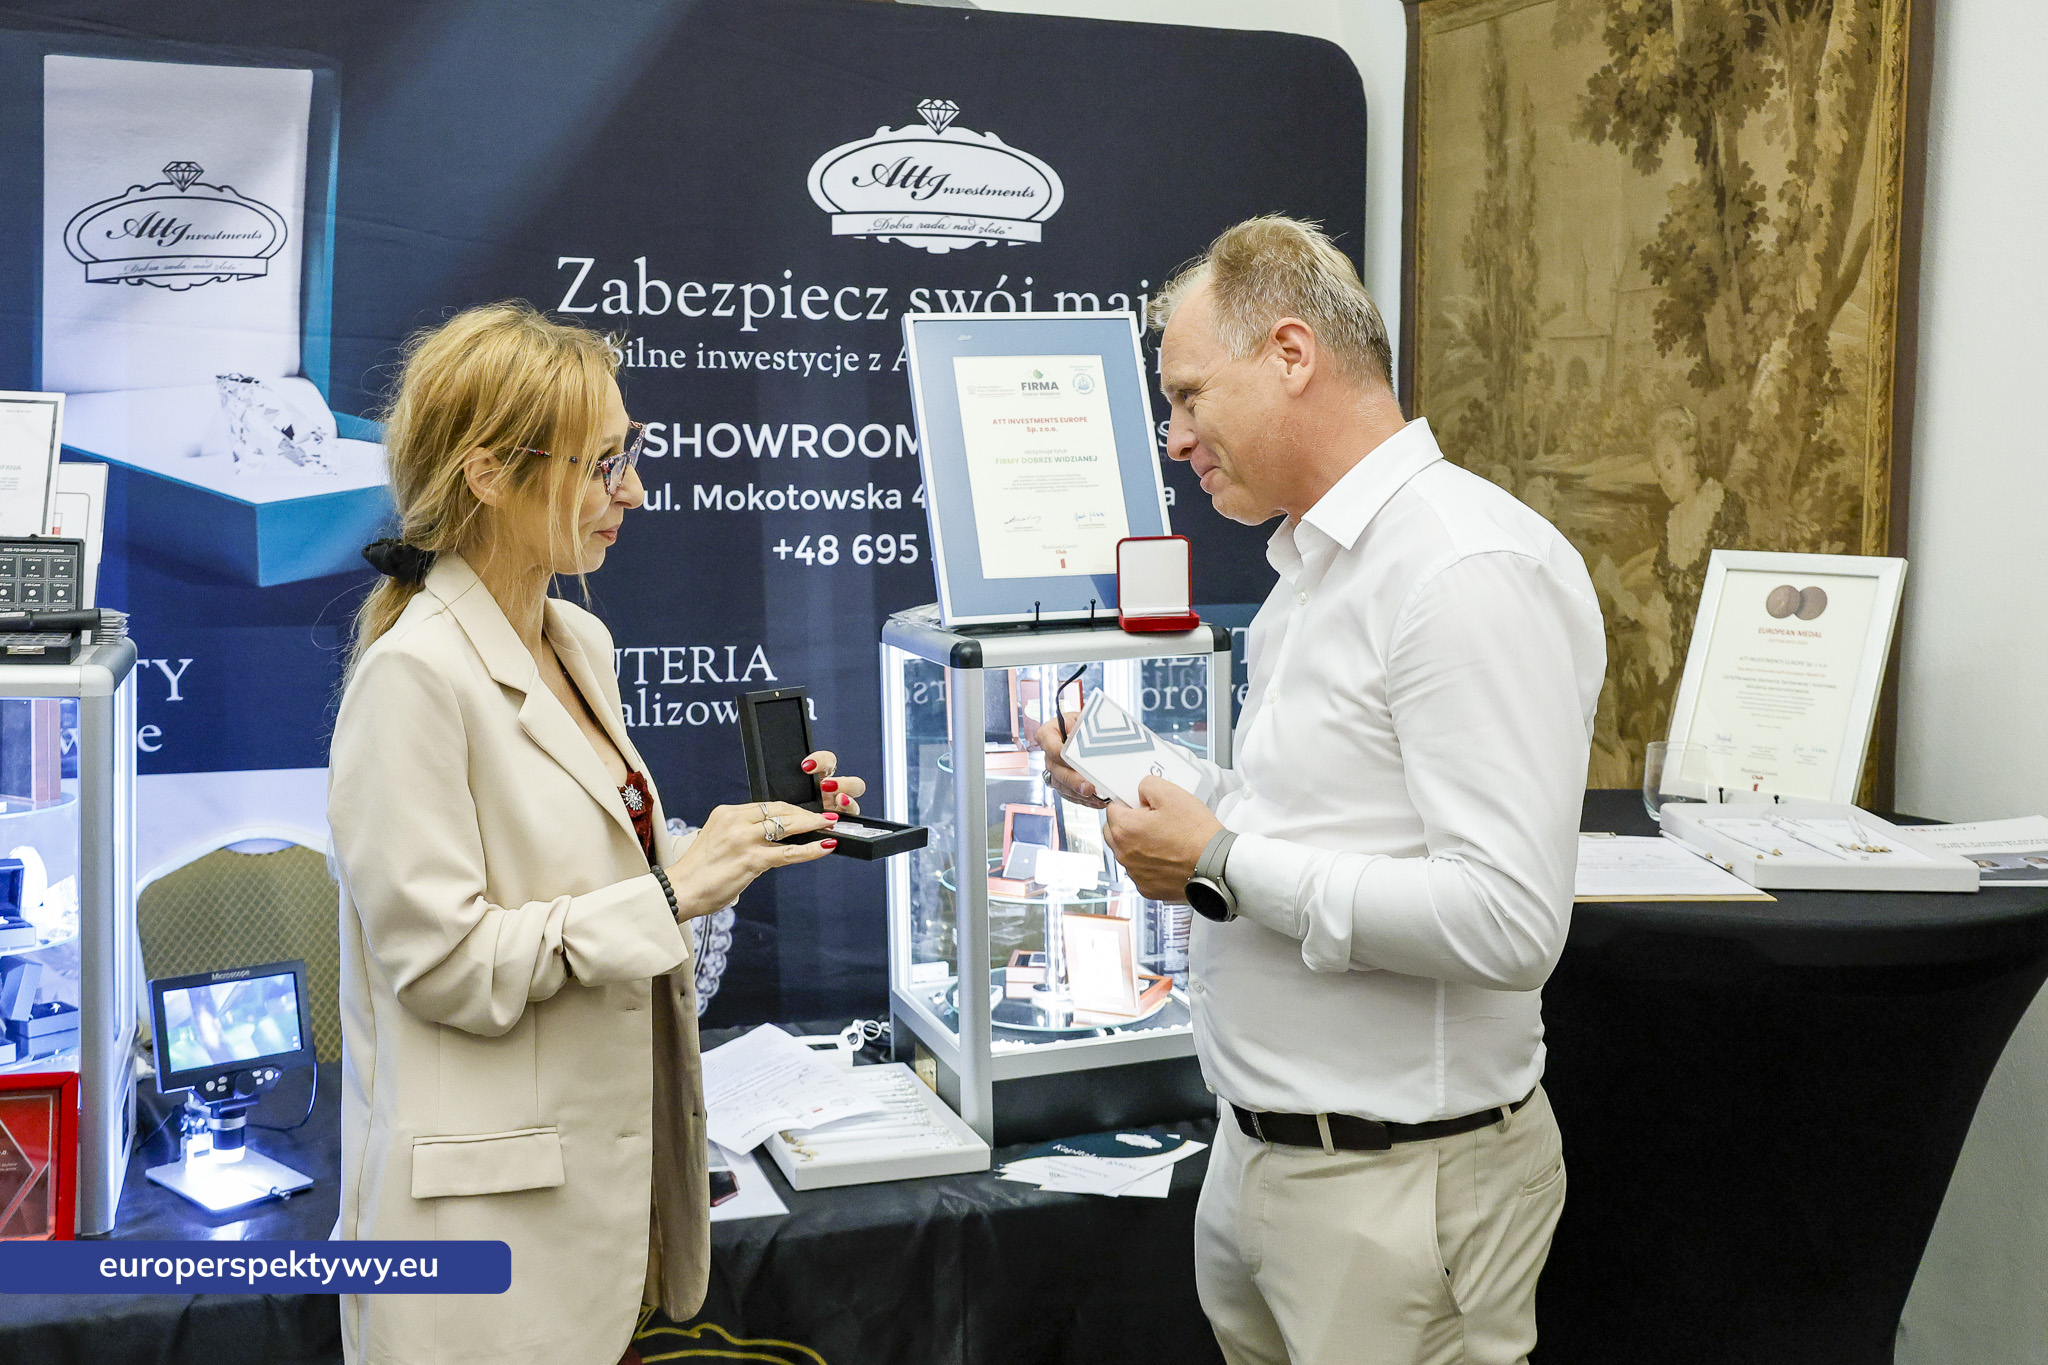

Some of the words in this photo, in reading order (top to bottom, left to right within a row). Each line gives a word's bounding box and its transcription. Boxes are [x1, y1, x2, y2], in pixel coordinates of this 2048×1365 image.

[916, 215, 952, 231] rada
[556, 255, 890, 332] Zabezpiecz
[604, 336, 687, 369] bilne
[696, 342, 860, 378] inwestycje
[868, 352, 882, 372] z
[1021, 381, 1060, 391] FIRMA
[642, 421, 920, 459] SHOWROOM
[995, 457, 1020, 465] FIRMY
[1021, 456, 1053, 464] DOBRZE
[1055, 455, 1098, 463] WIDZIANEJ
[643, 483, 681, 510] ul.
[693, 482, 902, 511] Mokotowska
[772, 534, 840, 566] +48
[852, 533, 919, 565] 695
[1758, 627, 1796, 636] EUROPEAN
[1797, 629, 1822, 638] MEDAL
[211, 970, 250, 981] Microscope
